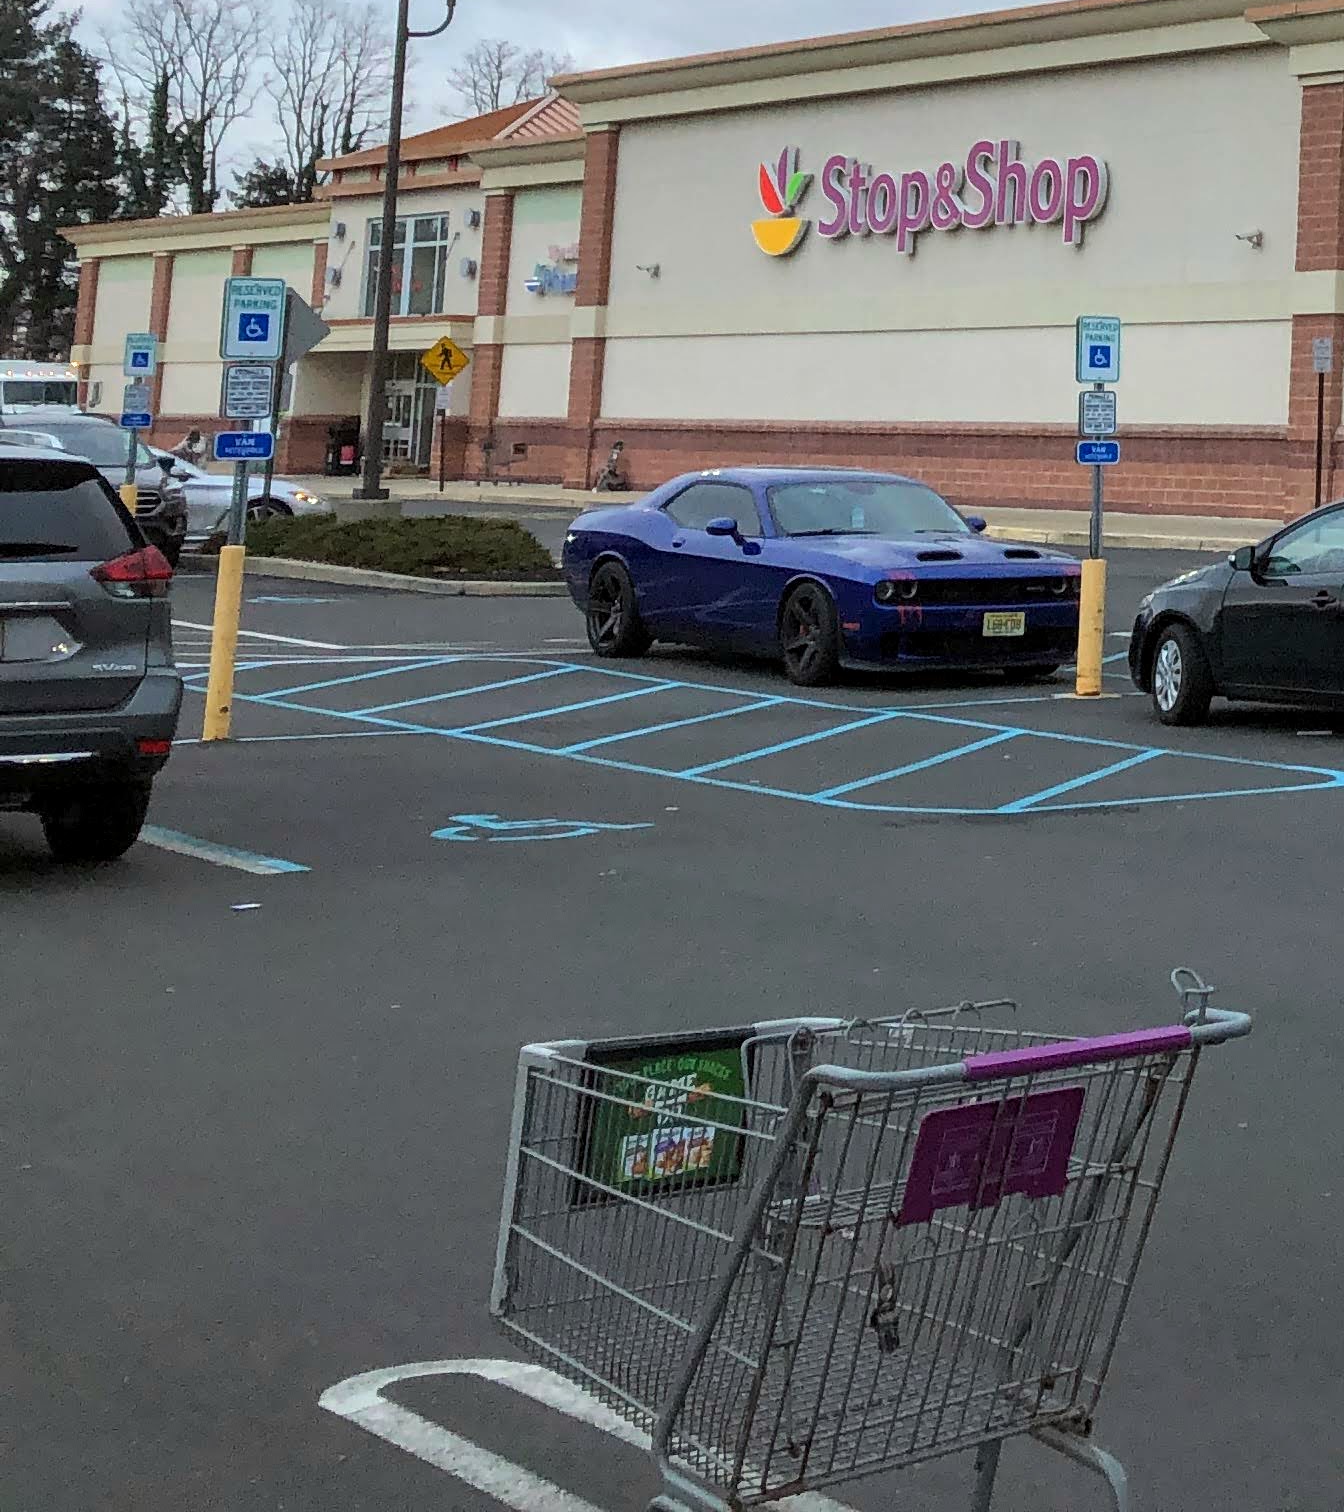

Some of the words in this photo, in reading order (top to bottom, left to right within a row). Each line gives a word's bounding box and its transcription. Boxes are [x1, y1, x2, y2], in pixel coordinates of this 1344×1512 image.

[817, 138, 1106, 253] Stop&Shop
[232, 284, 281, 296] RESERVED
[233, 298, 278, 310] PARKING
[1083, 321, 1118, 331] RESERVED
[1085, 332, 1115, 342] PARKING
[235, 438, 256, 446] VAN
